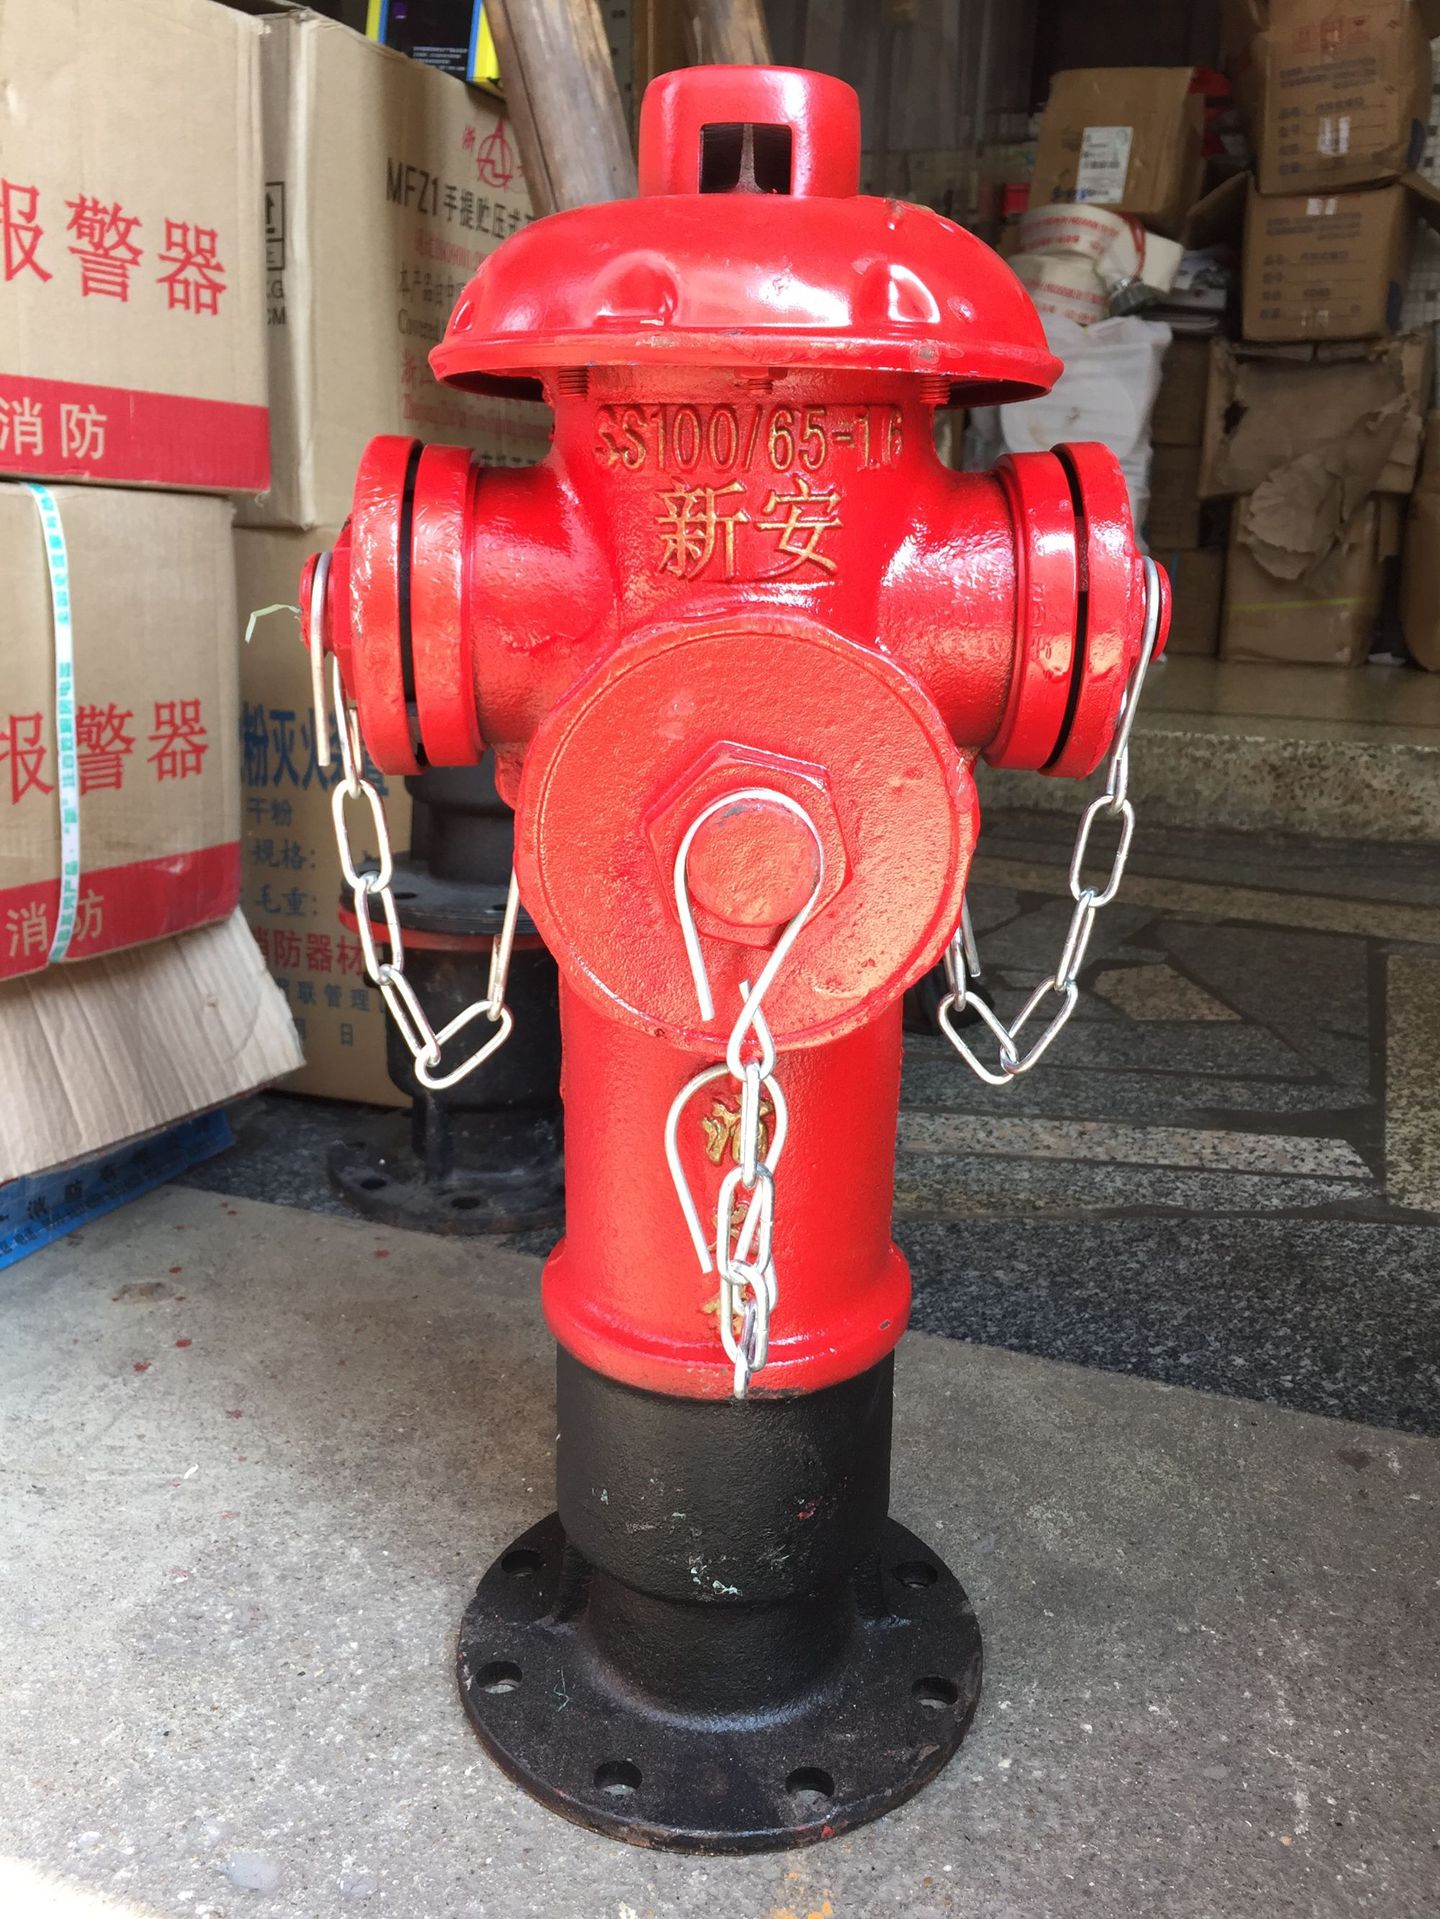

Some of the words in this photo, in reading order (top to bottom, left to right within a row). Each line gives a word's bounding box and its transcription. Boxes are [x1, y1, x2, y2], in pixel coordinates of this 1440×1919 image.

[0, 178, 227, 315] 报警器
[0, 396, 108, 459] 消防
[654, 476, 844, 580] 新安
[0, 697, 210, 806] 报警器
